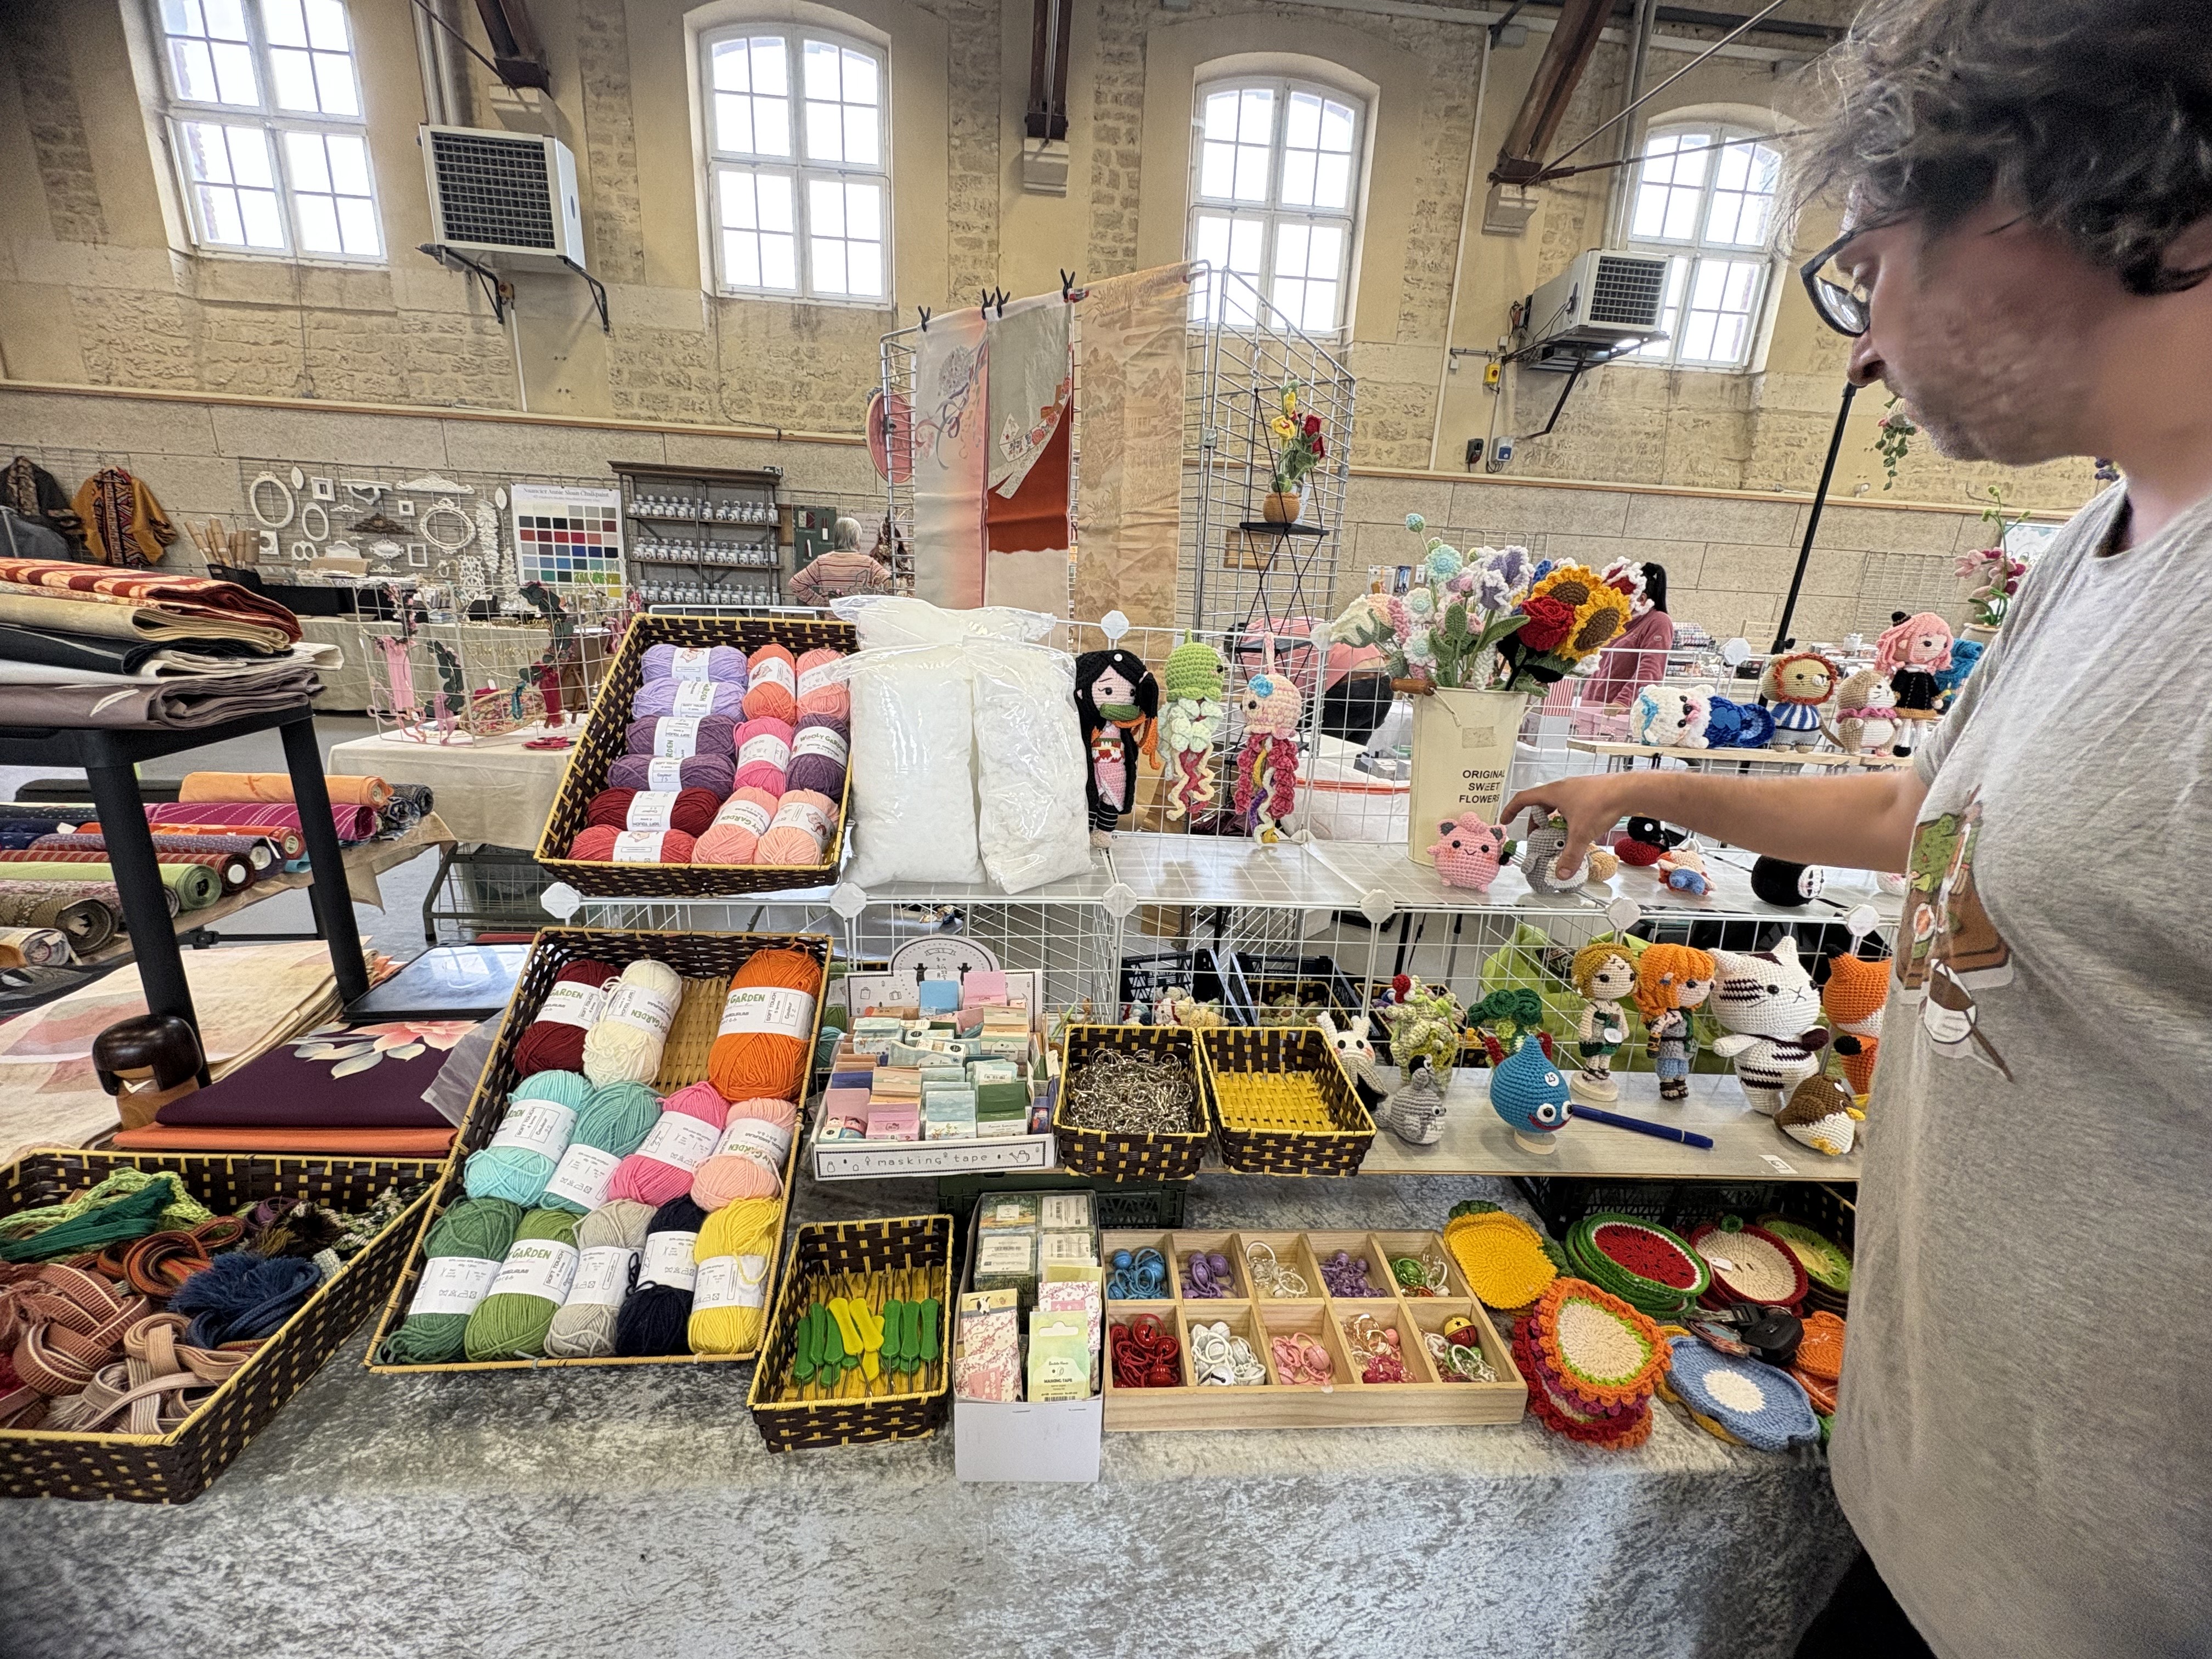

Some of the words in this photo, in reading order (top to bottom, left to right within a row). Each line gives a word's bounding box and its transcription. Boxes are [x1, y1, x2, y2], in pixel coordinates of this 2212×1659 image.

[665, 740, 674, 758] RDEN
[800, 733, 824, 742] WOOLY
[825, 736, 845, 754] GARDEN
[1463, 769, 1505, 778] ORIGINAL
[1468, 782, 1500, 791] SWEET
[1459, 794, 1500, 803] FLOWERS
[752, 823, 762, 835] OLY
[549, 988, 583, 999] GARDEN
[730, 993, 766, 1004] GARDEN
[631, 1009, 660, 1028] GARDEN
[524, 1107, 536, 1122] TOUCH
[535, 1118, 548, 1136] Couleur
[878, 1156, 941, 1166] masking
[953, 1154, 988, 1163] tape
[512, 1247, 552, 1259] GARDEN
[546, 1270, 555, 1284] SOFT
[552, 1251, 565, 1269] TOUCH
